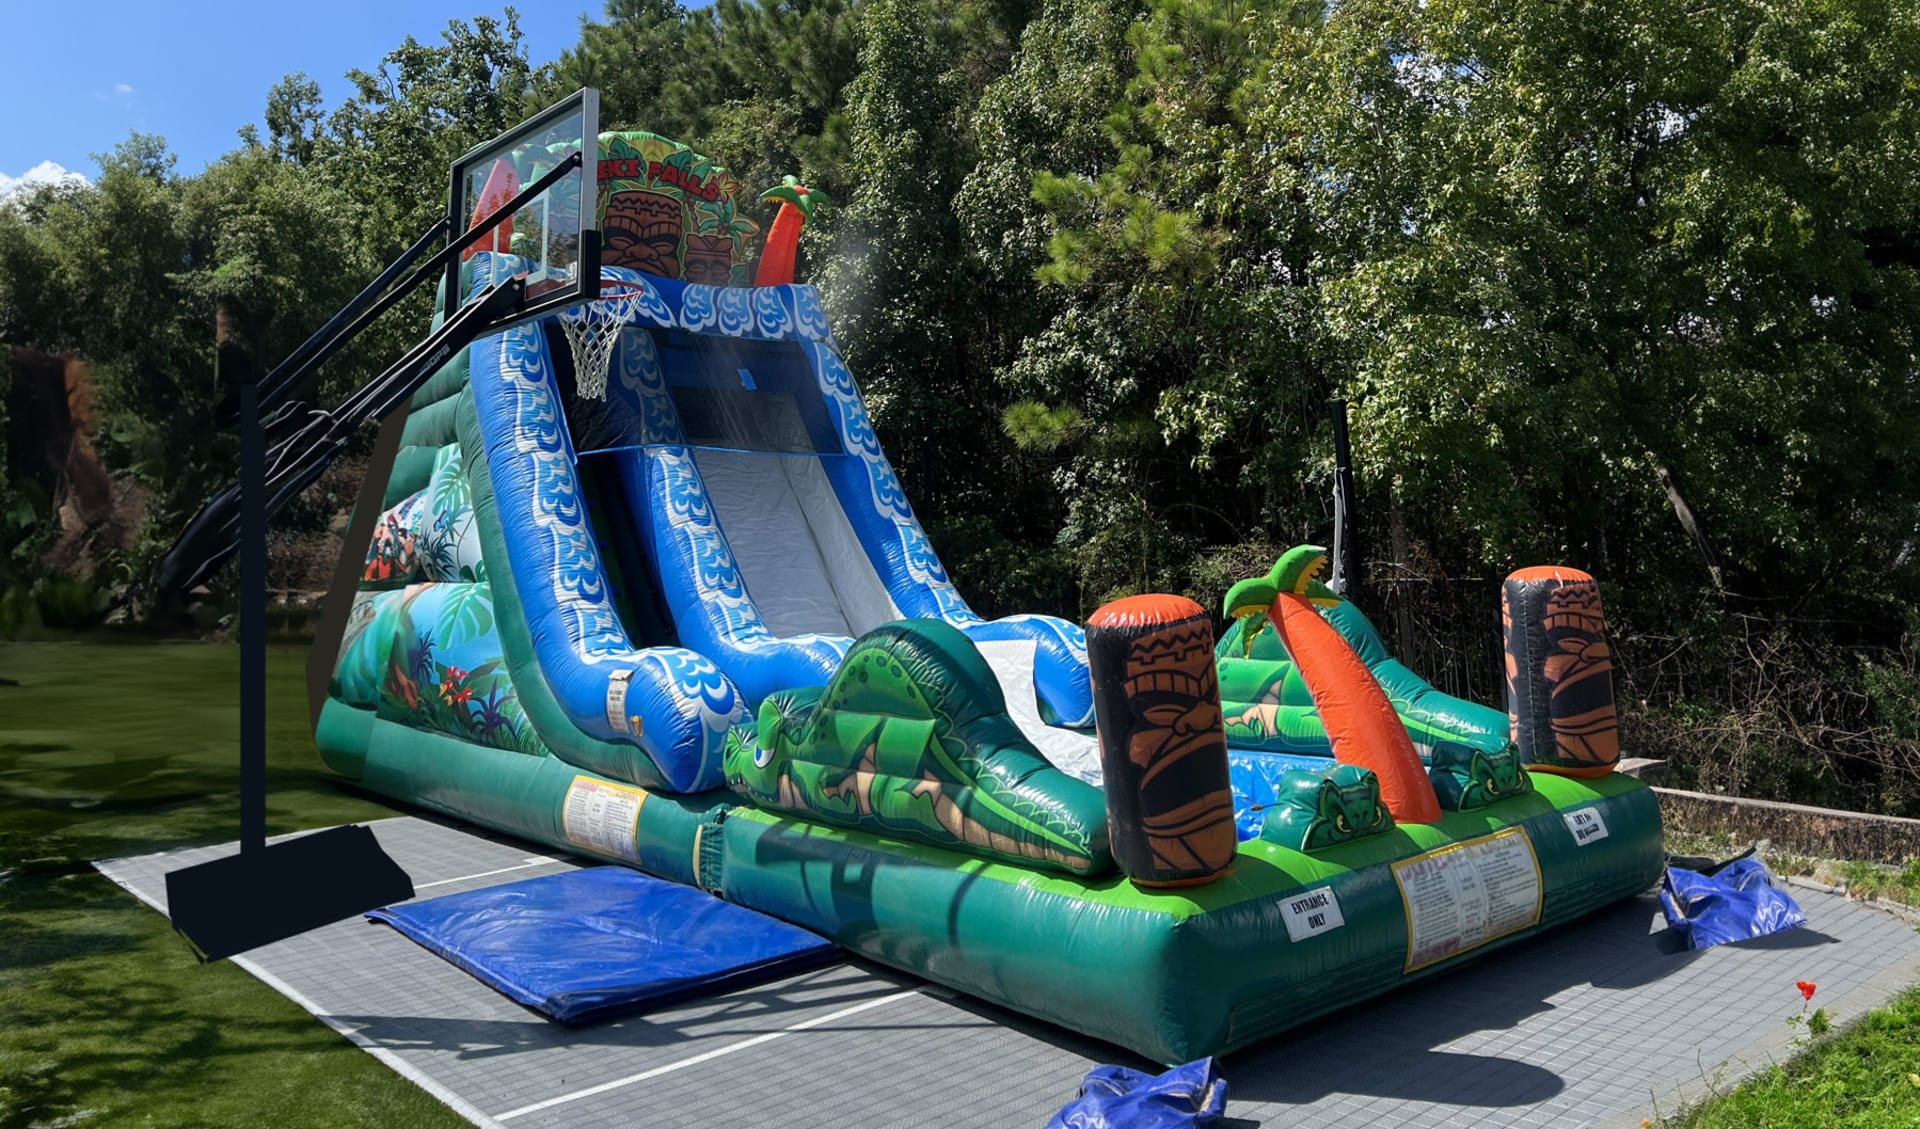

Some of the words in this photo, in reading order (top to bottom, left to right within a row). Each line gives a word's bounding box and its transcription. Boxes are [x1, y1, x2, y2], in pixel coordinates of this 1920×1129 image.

[597, 159, 641, 180] IKI
[647, 161, 720, 201] FALLS
[1291, 893, 1329, 915] ENTRANCE
[1307, 912, 1326, 929] ONLY
